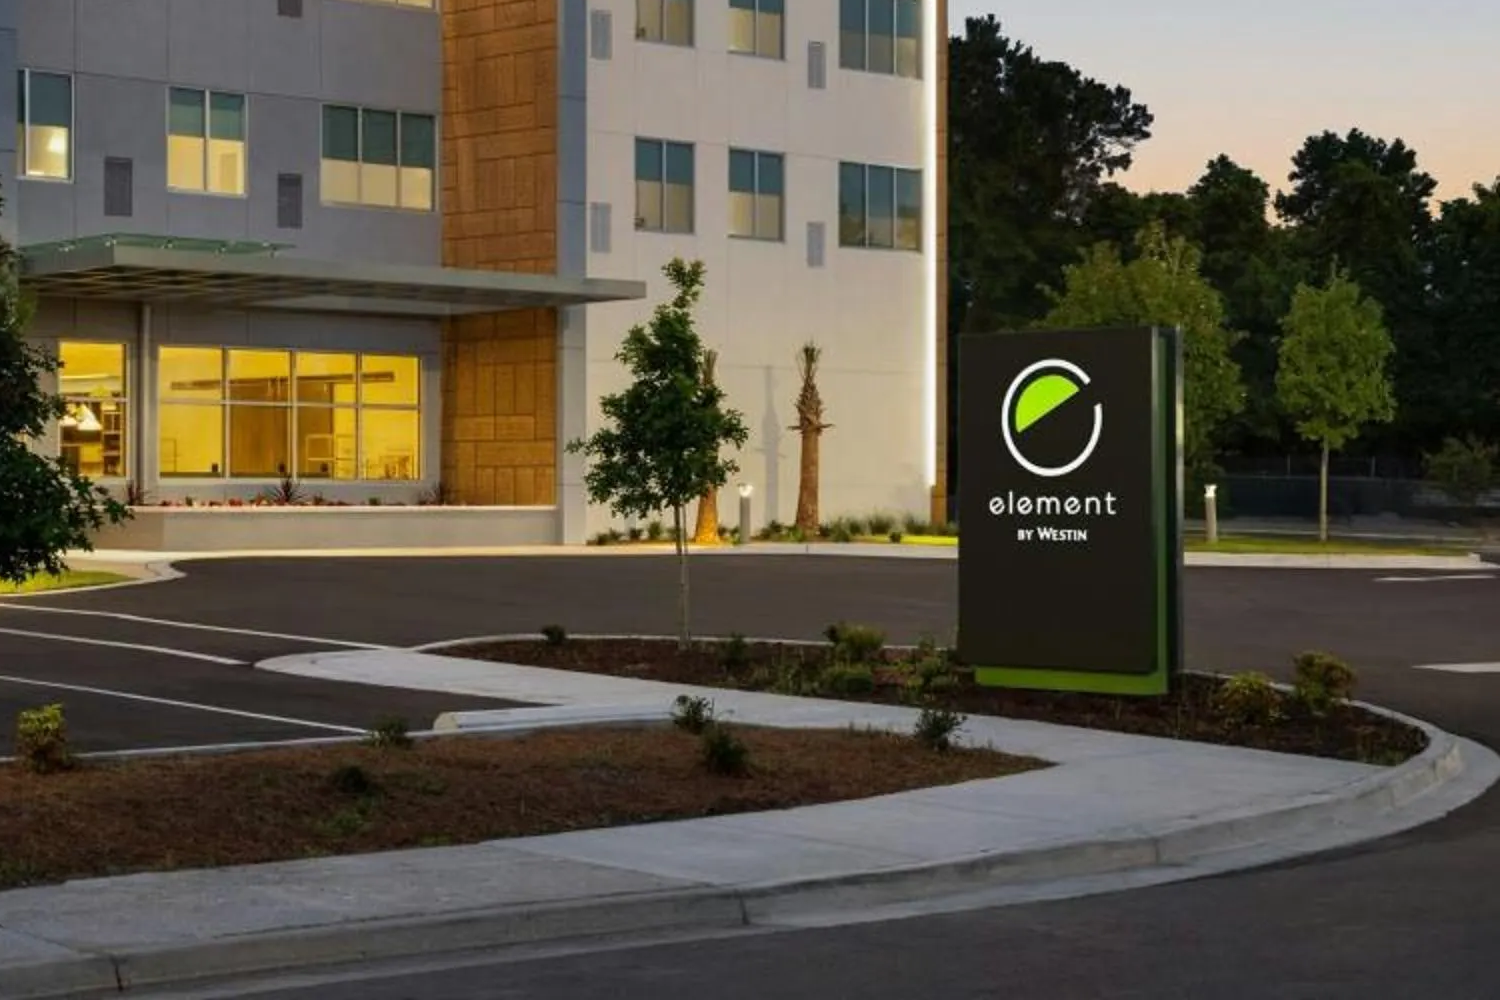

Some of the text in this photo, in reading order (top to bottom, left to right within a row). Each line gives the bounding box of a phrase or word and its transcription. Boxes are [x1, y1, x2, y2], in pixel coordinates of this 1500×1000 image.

[988, 490, 1117, 516] element
[1017, 526, 1088, 542] BY WESTIN
